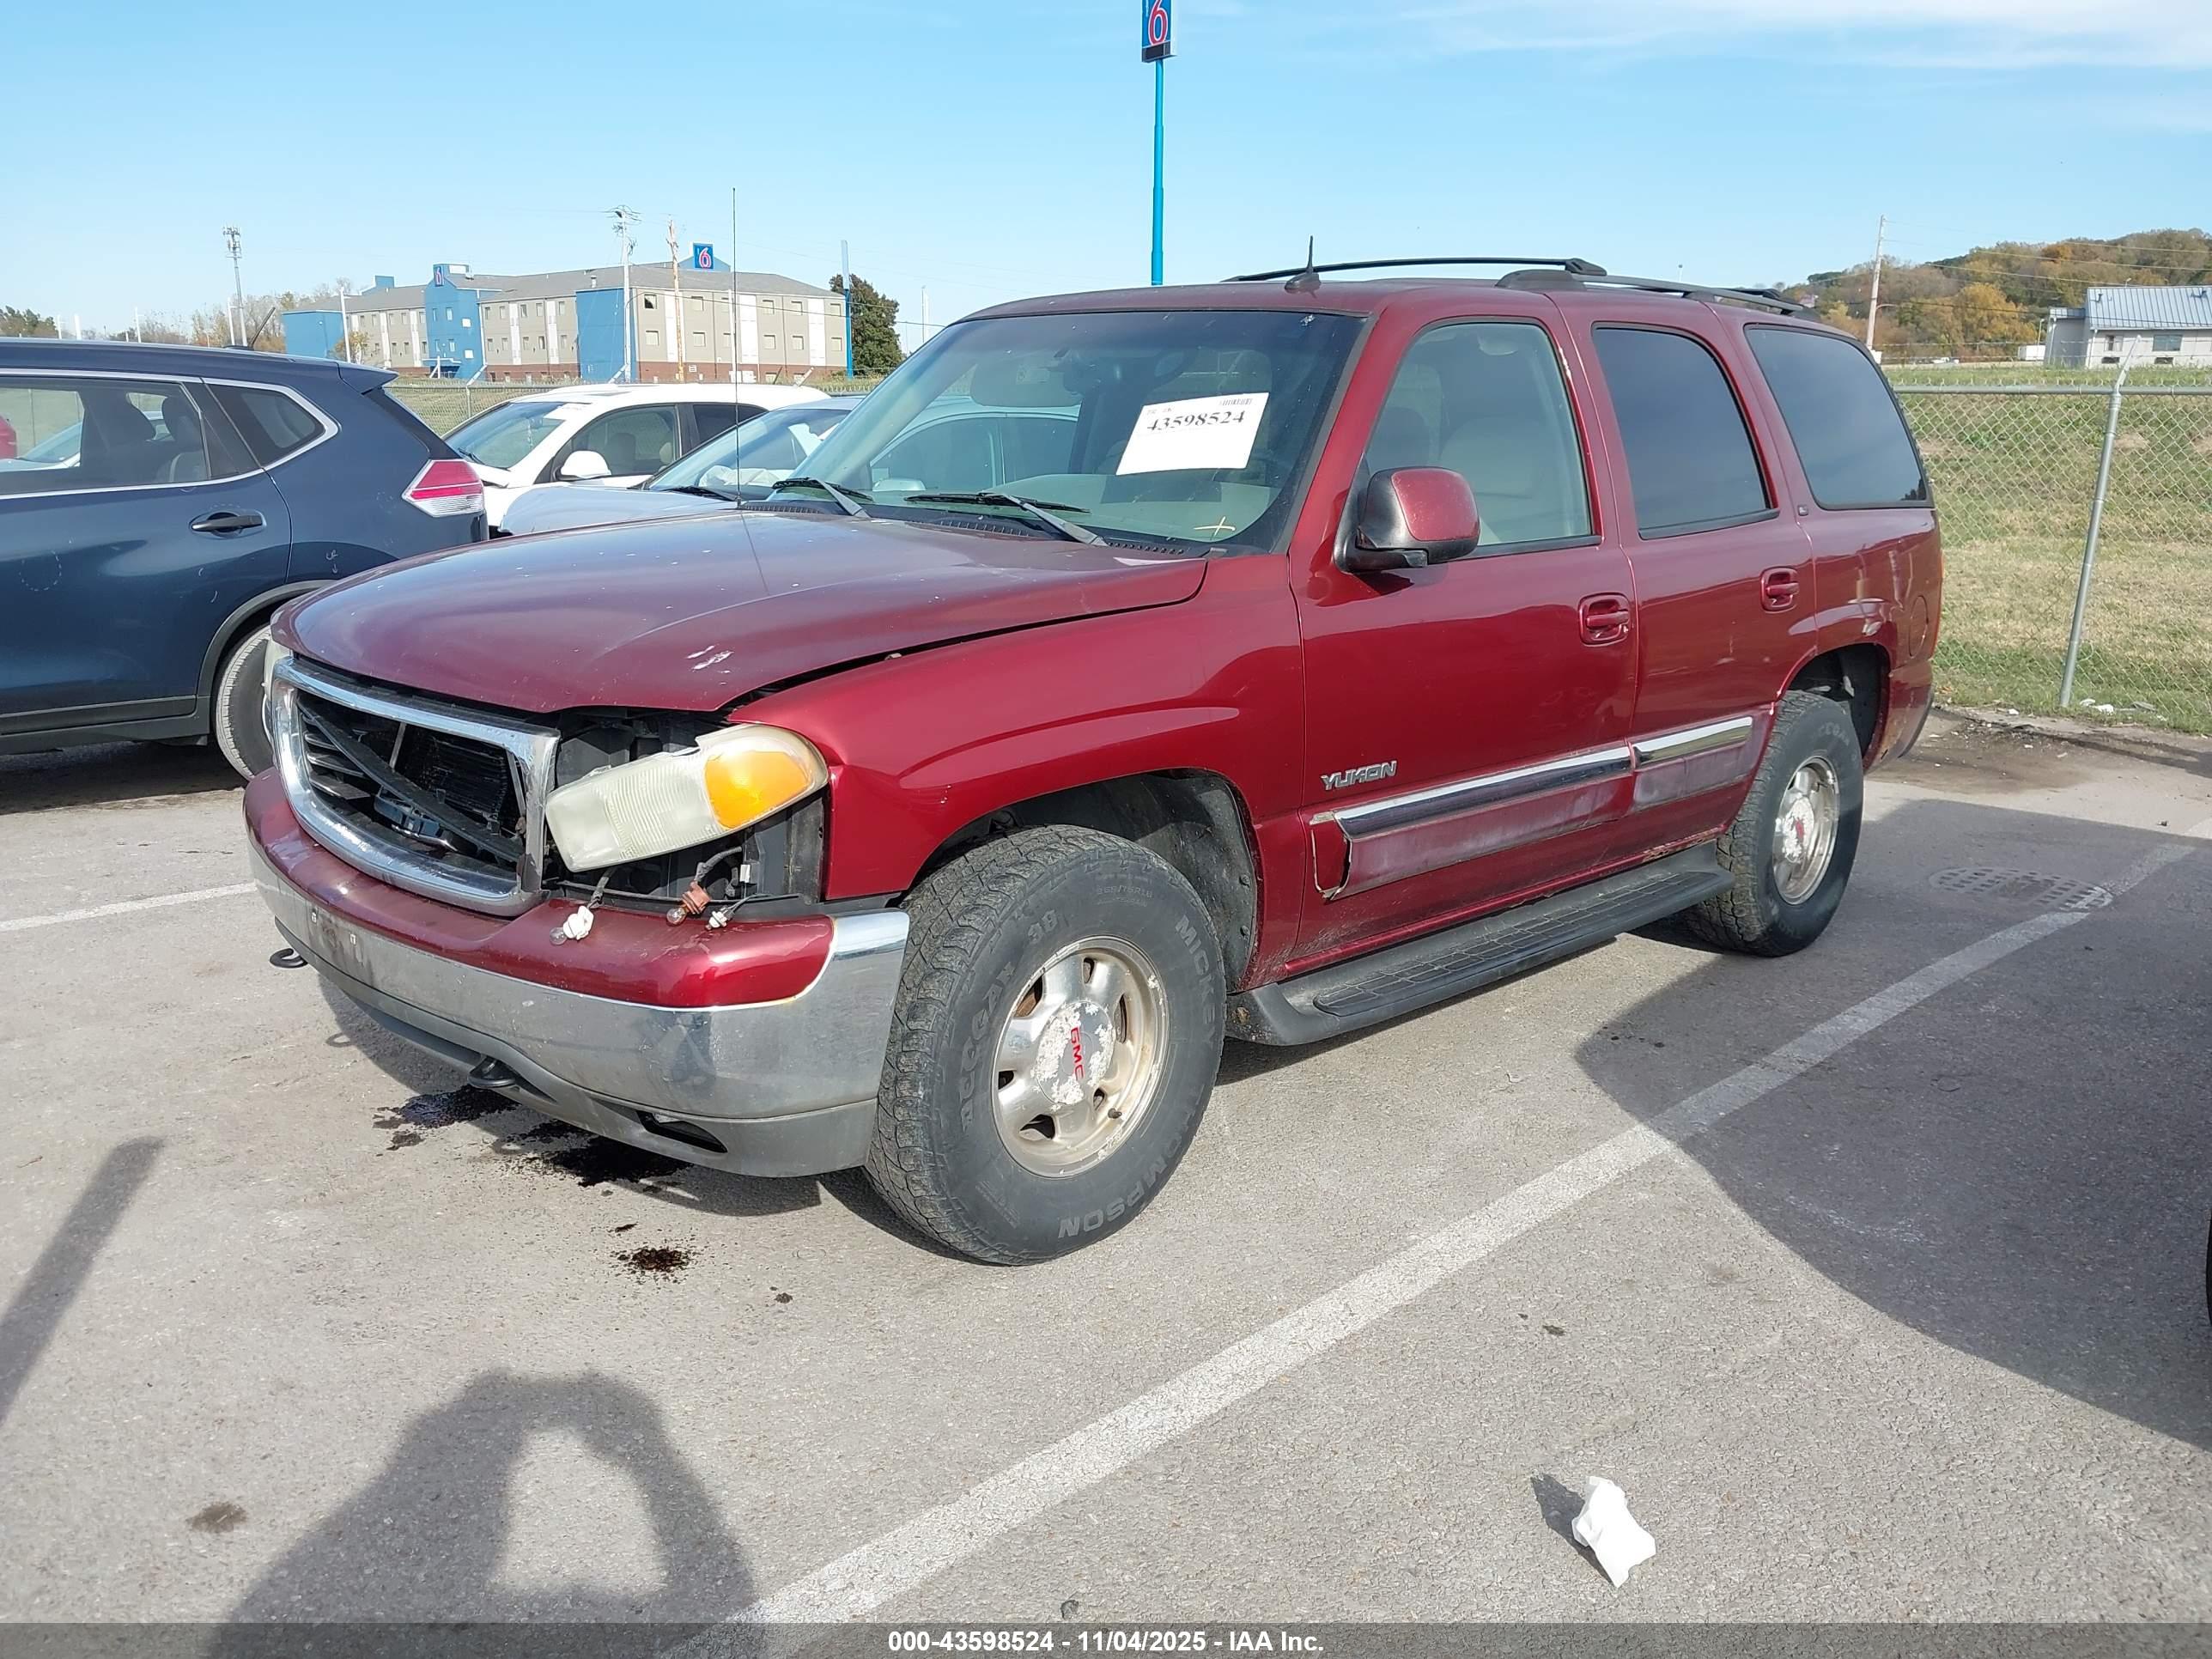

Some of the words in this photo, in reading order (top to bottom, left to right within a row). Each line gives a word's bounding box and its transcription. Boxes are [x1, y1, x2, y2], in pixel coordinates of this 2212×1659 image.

[1148, 0, 1168, 46] 6
[699, 247, 712, 269] 6
[435, 266, 442, 286] 6
[1146, 410, 1246, 431] 43598524
[1321, 760, 1398, 791] YUKON
[1174, 914, 1216, 1048] MICKEY
[1070, 1026, 1085, 1081] GMC
